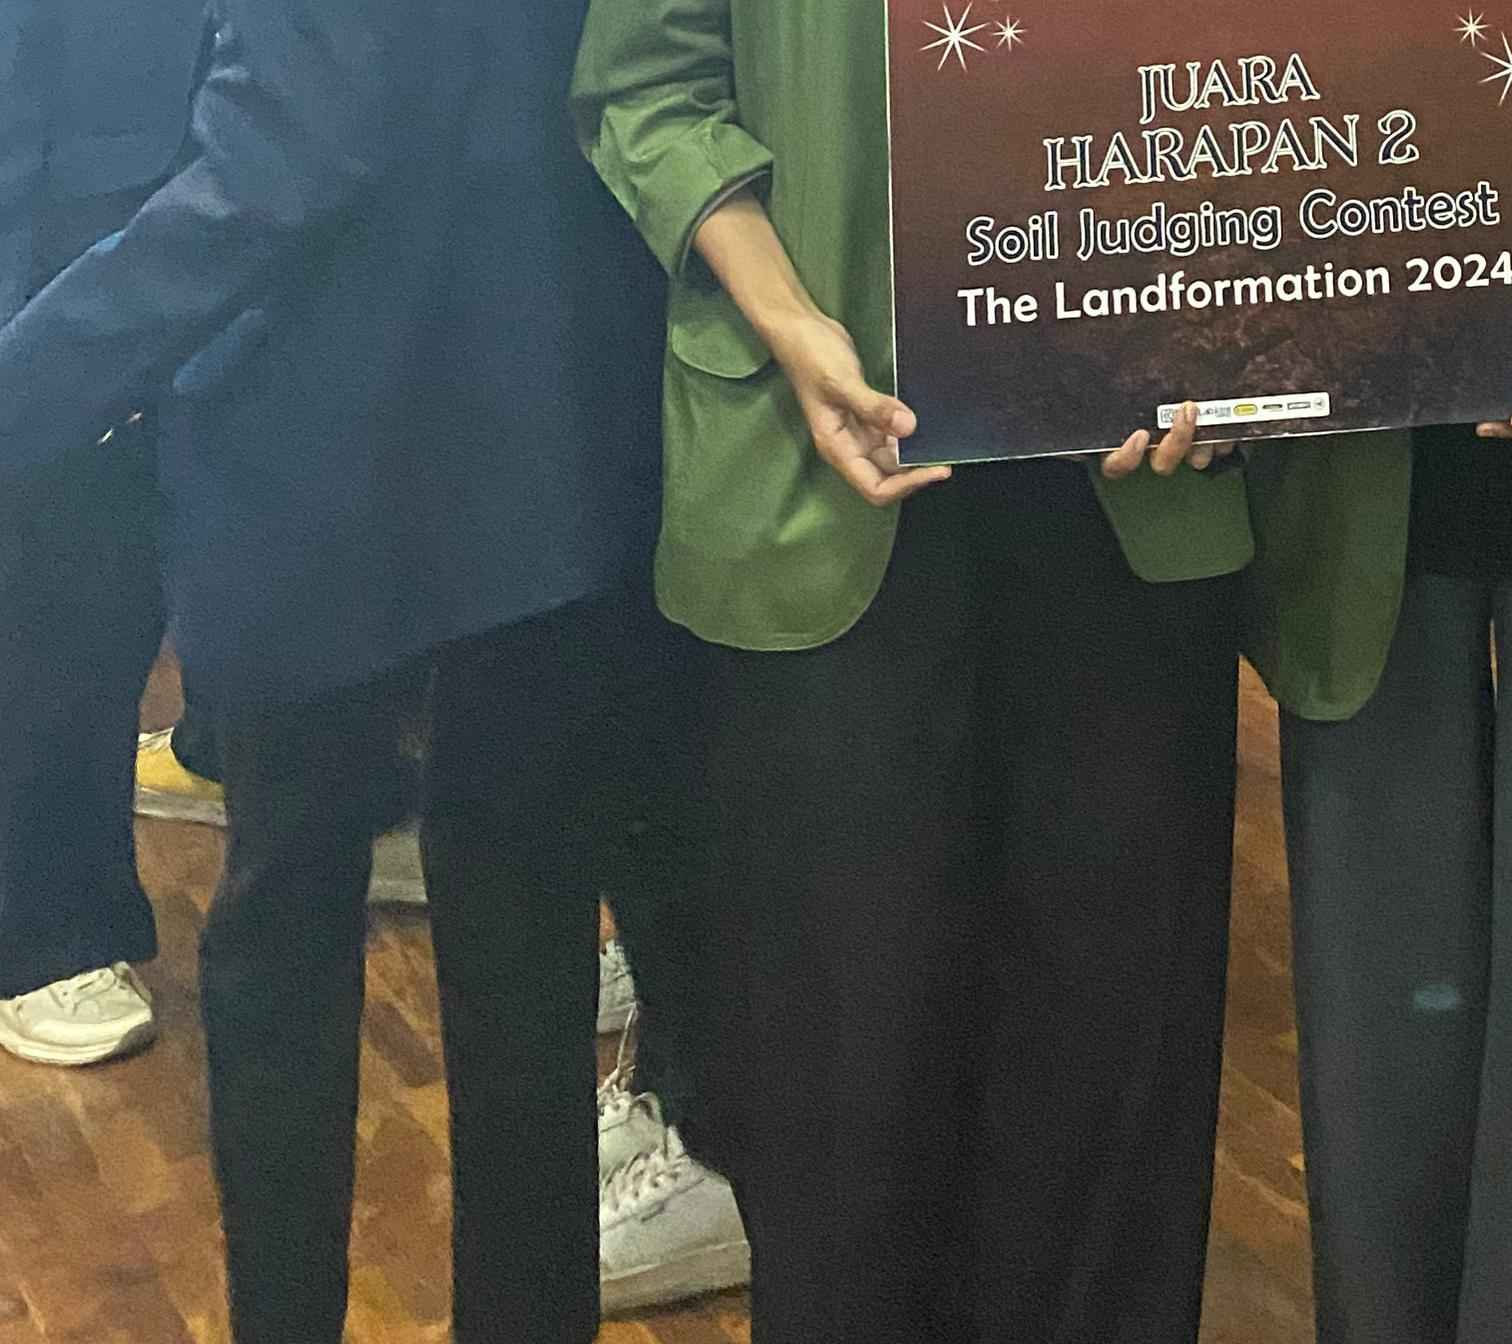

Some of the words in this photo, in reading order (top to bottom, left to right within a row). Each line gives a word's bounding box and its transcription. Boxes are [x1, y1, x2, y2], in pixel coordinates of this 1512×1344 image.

[1138, 53, 1320, 124] JUARA
[1043, 114, 1359, 191] HARAPAN
[1377, 109, 1420, 166] 2
[966, 211, 1059, 266] Soil
[1077, 201, 1282, 261] Judging
[1300, 180, 1501, 239] Contest
[957, 286, 1038, 327] The
[1055, 262, 1390, 320] Landformation
